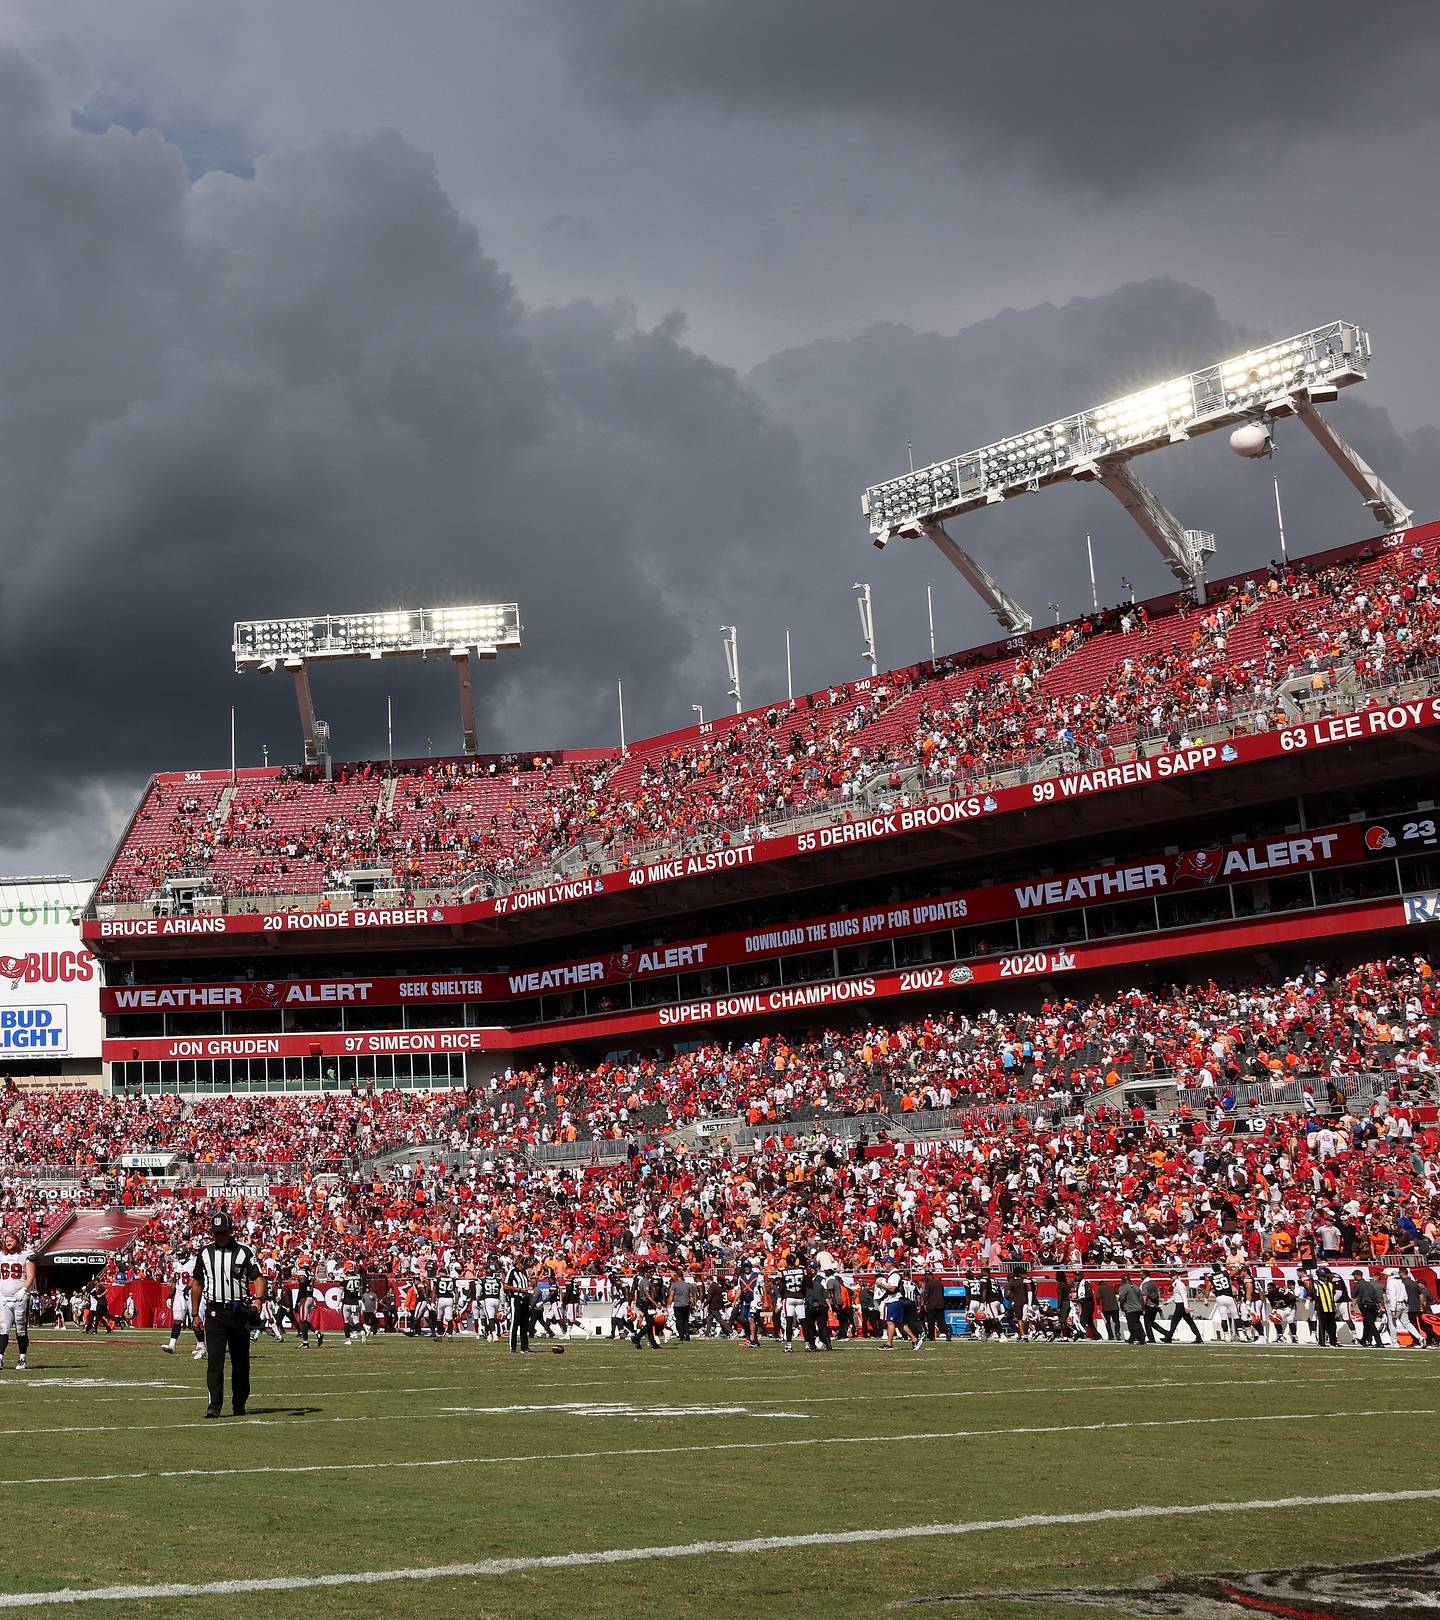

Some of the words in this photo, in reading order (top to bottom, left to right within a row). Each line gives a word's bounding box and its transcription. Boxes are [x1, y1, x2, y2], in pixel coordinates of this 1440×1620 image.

[1381, 532, 1407, 548] 337
[854, 679, 871, 692] 340
[699, 723, 713, 735] 341
[1280, 729, 1308, 751] 63
[1313, 716, 1363, 744] LEE
[1368, 702, 1424, 733] ROY
[184, 772, 202, 782] 344
[1032, 782, 1056, 802] 99
[1059, 759, 1152, 796] WARREN
[1158, 746, 1217, 778] SAPP
[797, 832, 817, 852] 55
[819, 815, 898, 848] DERRICK
[900, 797, 981, 832] BROOKS
[1402, 819, 1437, 840] 23
[628, 868, 645, 886] 40
[647, 860, 684, 883] MIKE
[686, 844, 755, 874] ALSTOTT
[1015, 863, 1167, 909] WEATHER
[1222, 833, 1339, 876] ALERT
[494, 897, 509, 915] 47
[511, 889, 546, 911] JOHN
[549, 879, 593, 903] LYNCH
[101, 920, 159, 937] BRUCE
[162, 917, 226, 935] ARIANS
[263, 917, 283, 931] 20
[287, 910, 350, 929] RONDÉ
[354, 909, 429, 927] BARBER
[745, 931, 804, 953] DOWNLOAD
[806, 925, 827, 943] THE
[829, 917, 861, 938] BUCS
[862, 913, 886, 933] APP
[888, 909, 911, 928] FOR
[913, 899, 968, 925] UPDATES
[24, 950, 94, 983] BUCS
[509, 960, 605, 994] WEATHER
[637, 942, 708, 973] ALERT
[999, 952, 1048, 977] 2020
[115, 987, 242, 1008] WEATHER
[286, 982, 373, 1002] ALERT
[399, 982, 429, 998] SEEK
[431, 980, 483, 996] SHELTER
[659, 999, 712, 1025] SUPER
[715, 992, 766, 1018] BOWL
[769, 977, 876, 1012] CHAMPIONS
[899, 967, 945, 991] 2002
[0, 1009, 52, 1029] BUD
[169, 1040, 203, 1057] JON
[207, 1039, 280, 1055] GRUDEN
[344, 1037, 364, 1052] 97
[367, 1034, 434, 1051] SIMEON
[437, 1033, 482, 1048] RICE
[206, 1186, 271, 1198] BUCCANEERS
[54, 1256, 87, 1264] GEICO
[1301, 1247, 1312, 1260] 2
[0, 1262, 22, 1280] 69
[438, 1280, 454, 1294] 94
[1212, 1274, 1231, 1291] 58
